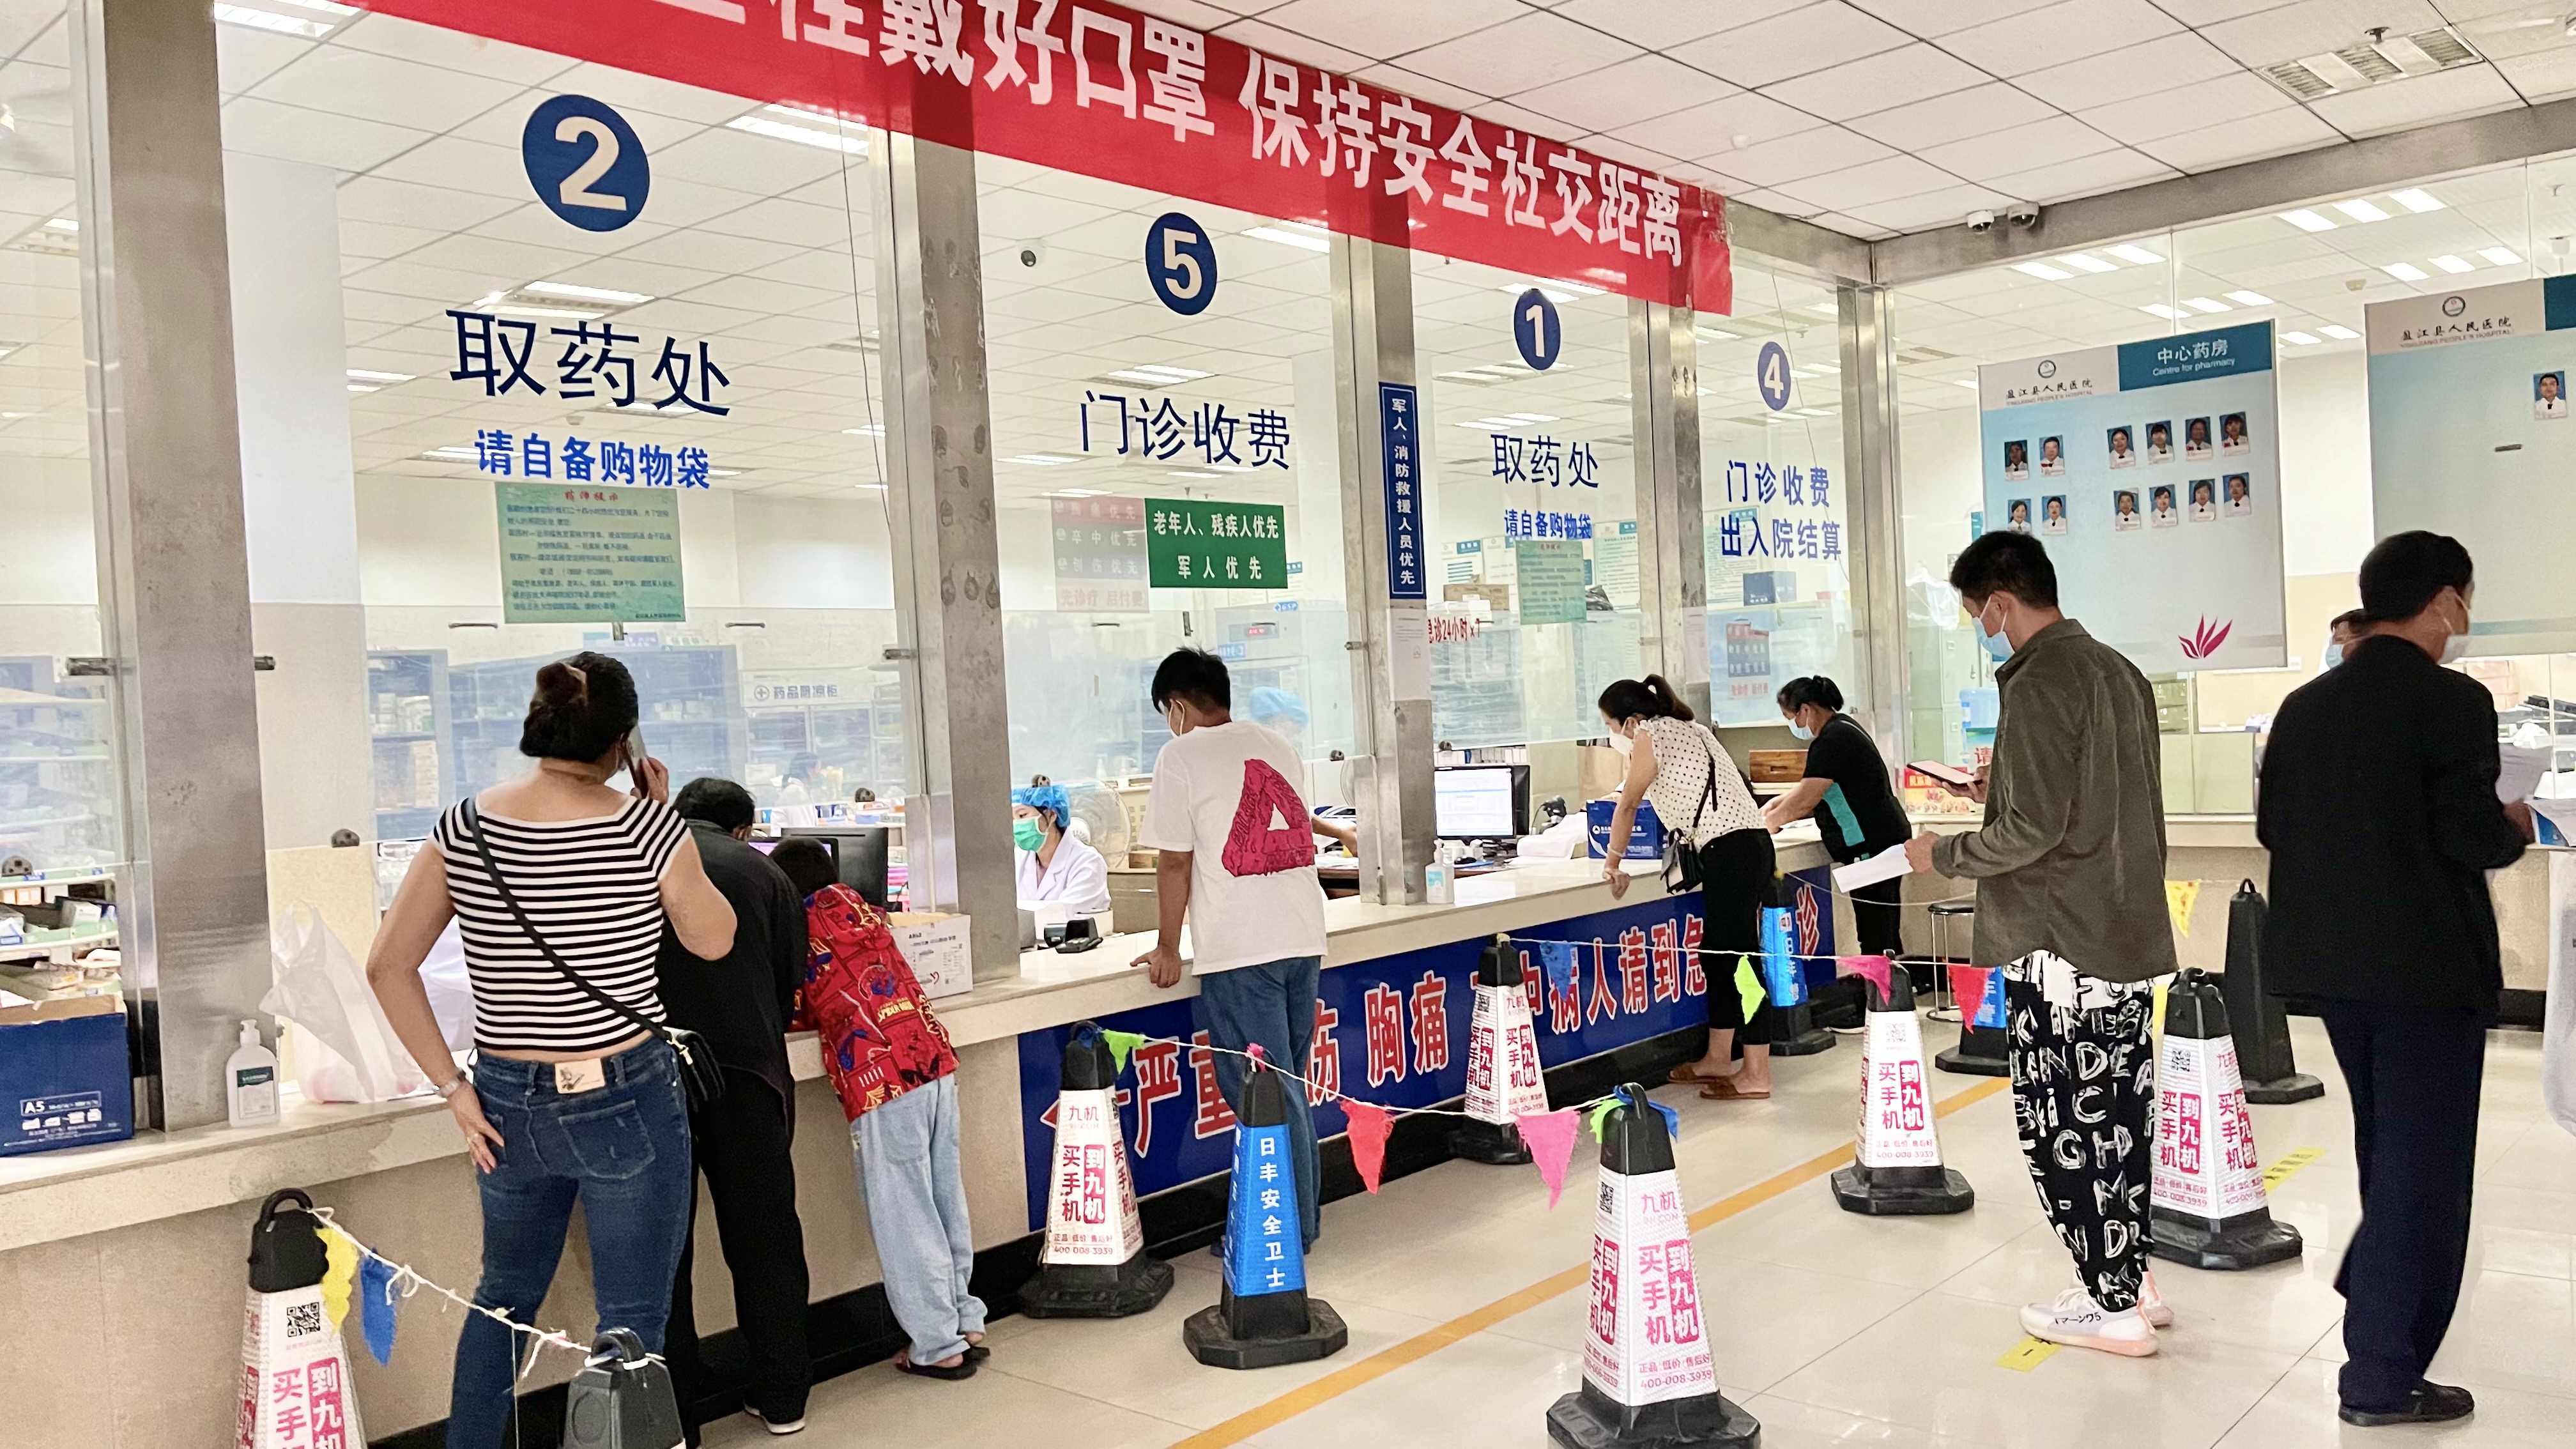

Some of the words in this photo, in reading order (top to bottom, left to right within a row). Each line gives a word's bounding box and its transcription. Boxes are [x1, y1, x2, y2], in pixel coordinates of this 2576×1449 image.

[555, 116, 627, 211] 2
[661, 0, 1215, 142] 戴好口罩
[1239, 48, 1682, 268] 保持安全社交距离
[1164, 229, 1202, 299] 5
[446, 309, 731, 416] 取药处
[1524, 303, 1546, 358] 1
[2158, 339, 2228, 364] 中心药房
[1764, 353, 1784, 399] 4
[2152, 365, 2180, 376] Centre
[2182, 363, 2193, 372] for
[2195, 358, 2235, 371] pharmacy
[474, 429, 711, 489] 请自备购物袋
[1080, 390, 1290, 470] 门诊收费
[1491, 434, 1598, 488] 取药处
[1391, 398, 1415, 586] 军人、消防救援人员优先
[1726, 460, 1830, 508] 门诊收费
[1154, 510, 1280, 539] 老年人、残疾人优先
[1504, 509, 1591, 539] 请自备购物袋
[1721, 515, 1841, 561] 出入院结算
[1178, 556, 1262, 580] 军人优先
[1365, 969, 1448, 1089] 胸痛
[1506, 1027, 1523, 1088] 买手机
[24, 1100, 45, 1114] A5
[1069, 1106, 1100, 1121] 九机
[1878, 1062, 1901, 1130] 买手机
[1900, 1063, 1924, 1129] 到九机
[2160, 1091, 2177, 1168] 买手机
[2181, 1098, 2200, 1170] 到九机
[2218, 1093, 2242, 1171] 买手机
[1062, 1144, 1082, 1222] 买手机
[1085, 1148, 1105, 1221] 到九机
[1259, 1137, 1285, 1288] 日丰安全卫士
[1641, 1191, 1678, 1214] 九机
[1601, 1245, 1618, 1340] 到九机
[1638, 1245, 1671, 1346] 买手机
[1669, 1246, 1699, 1339] 到九机
[273, 1368, 307, 1449] 买手
